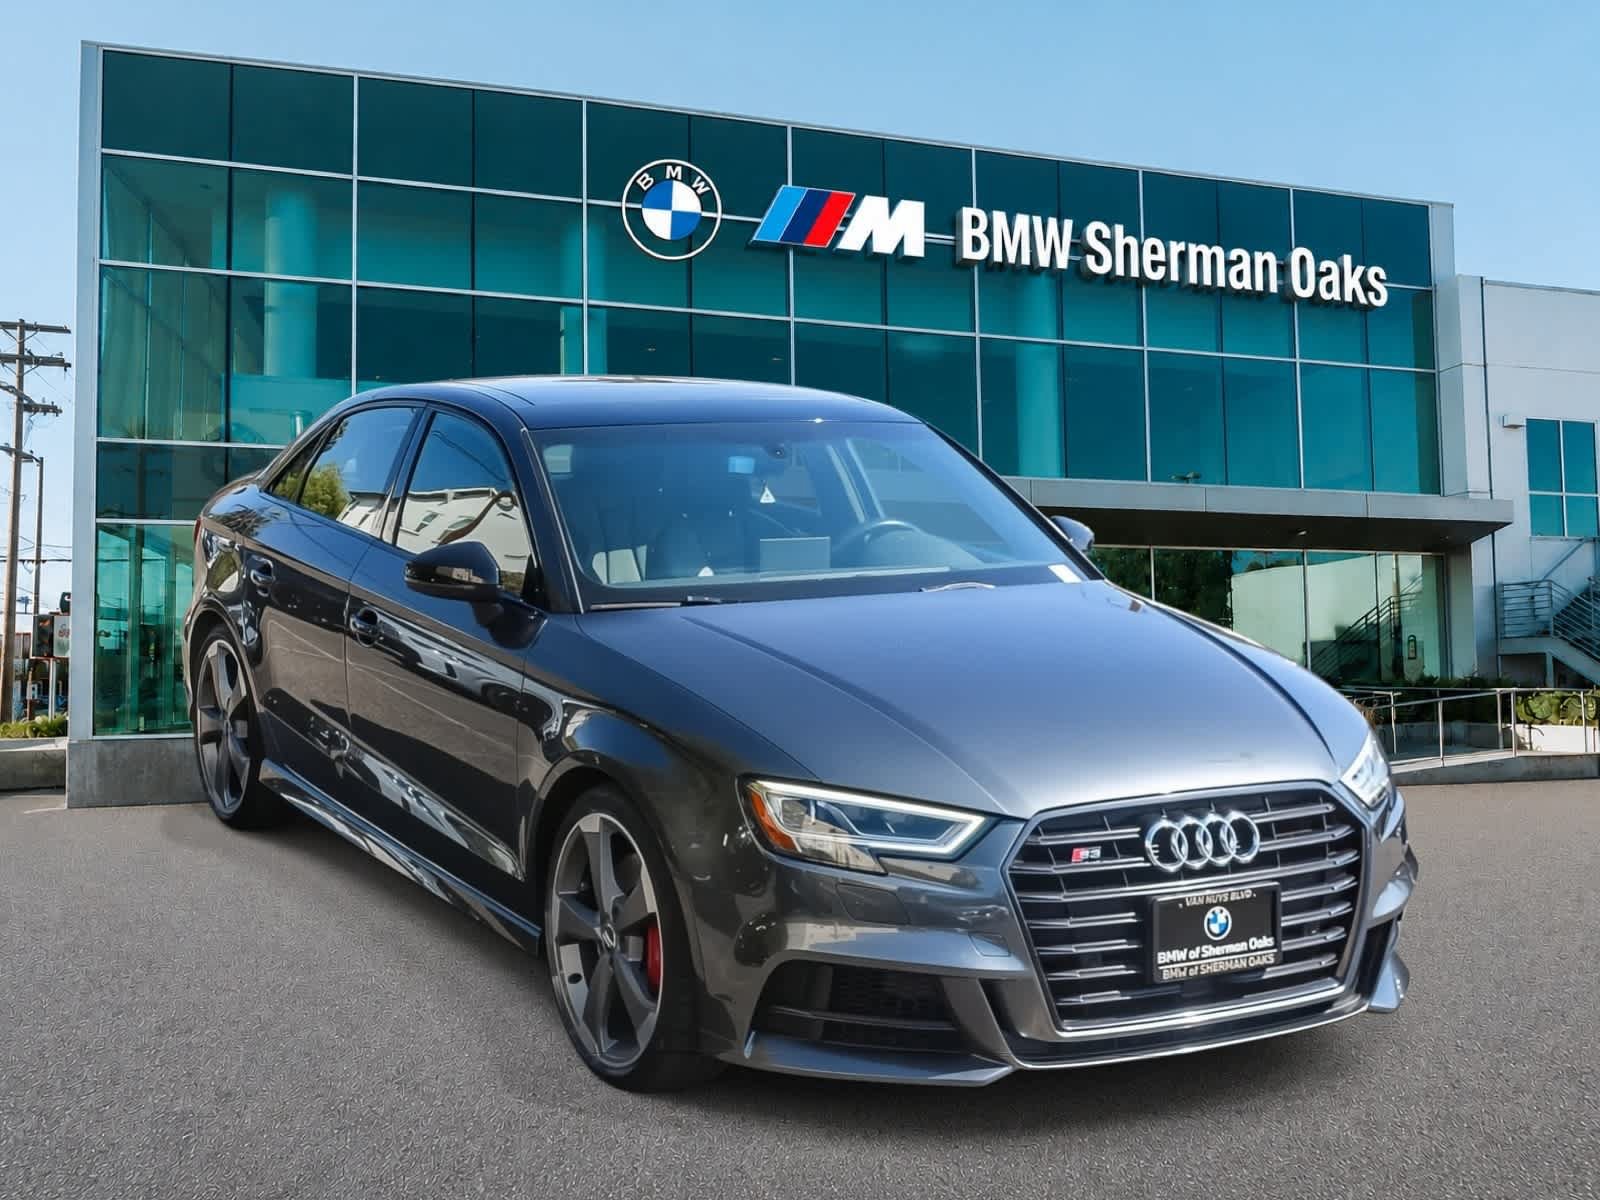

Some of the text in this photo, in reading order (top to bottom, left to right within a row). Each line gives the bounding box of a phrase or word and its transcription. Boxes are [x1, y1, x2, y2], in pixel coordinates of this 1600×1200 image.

[637, 165, 710, 196] BMW
[834, 195, 925, 257] M
[960, 206, 1388, 308] BMW Sherman Oaks
[1157, 935, 1275, 964] BMW of Sherman Oaks
[1162, 953, 1275, 980] BMW of SHERMAN OAKS
